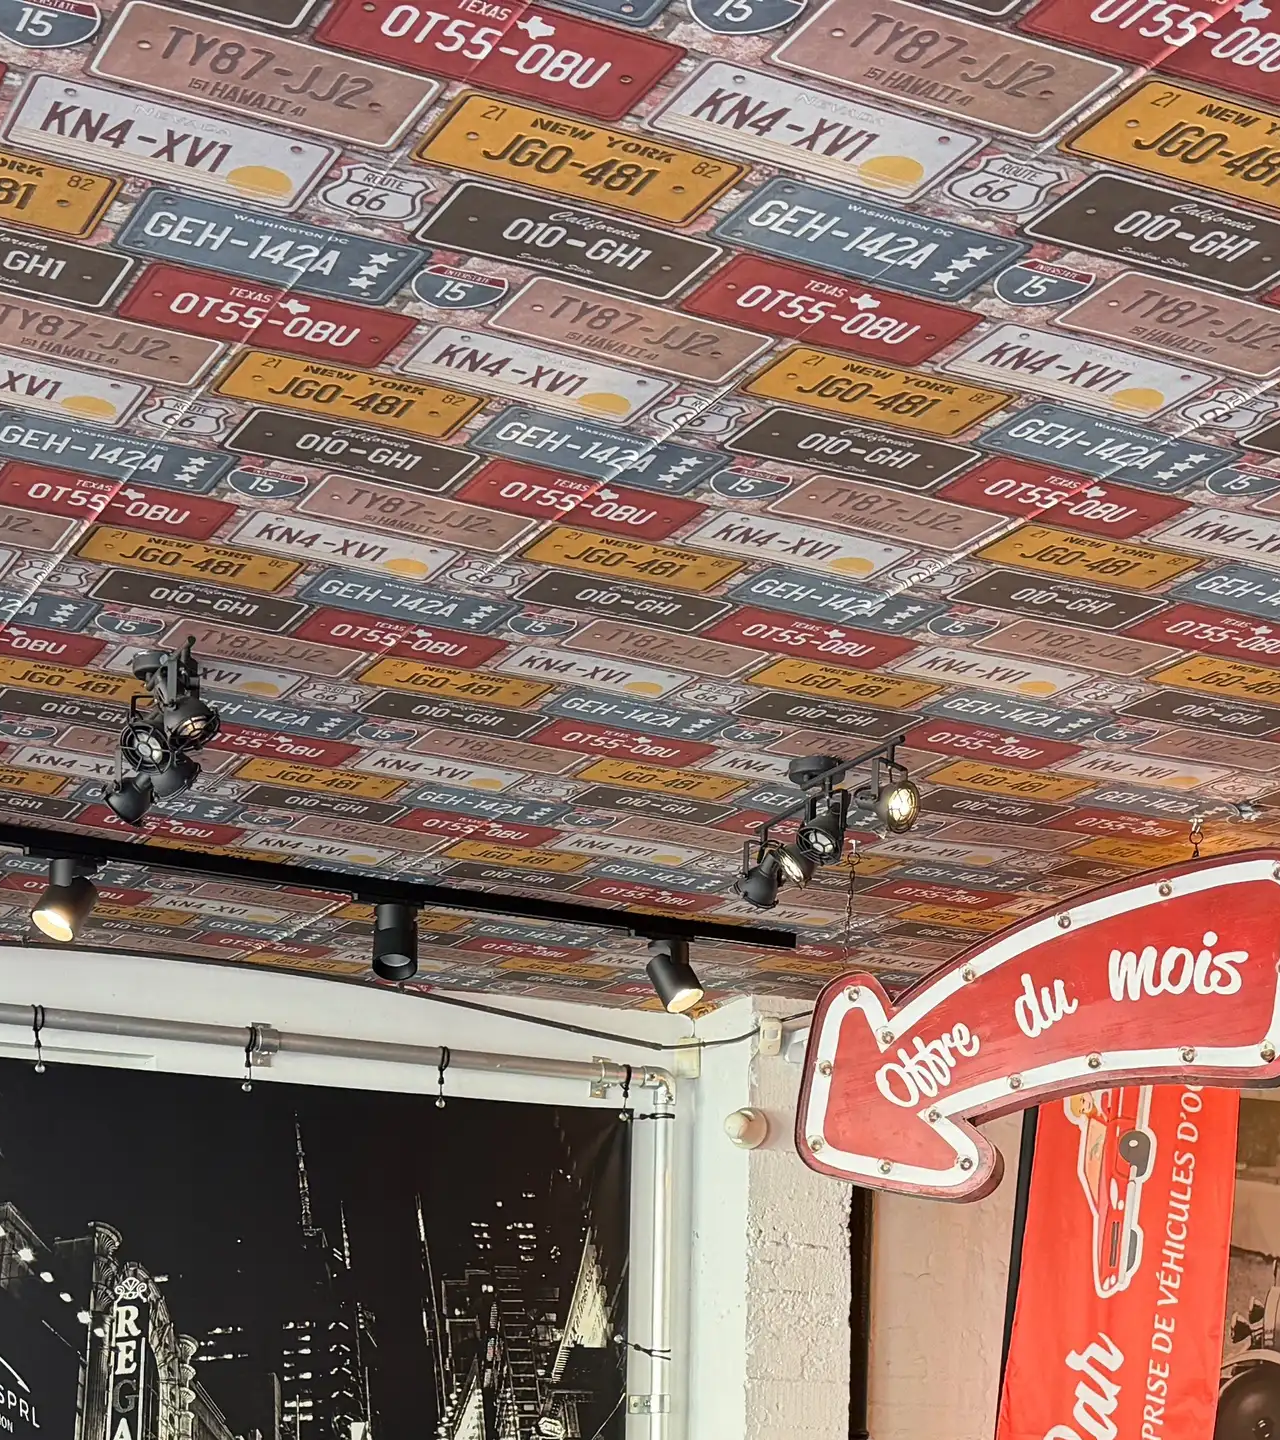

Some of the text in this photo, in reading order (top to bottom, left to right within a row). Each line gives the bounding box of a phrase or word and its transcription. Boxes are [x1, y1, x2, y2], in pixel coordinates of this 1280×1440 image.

[38, 101, 232, 172] KN4-XV1
[528, 117, 677, 163] NEW YORK
[688, 88, 878, 162] KN4-XV1
[1192, 105, 1259, 129] NEW
[360, 173, 411, 190] ROUTE
[478, 135, 662, 195] JGO-481
[993, 163, 1046, 181] ROUTE
[344, 188, 393, 211] 66
[966, 179, 1021, 202] 66
[142, 209, 342, 277] GEH-142A
[747, 199, 940, 269] GEH-142A
[437, 280, 476, 300] 15
[802, 280, 850, 298] TEXAS
[1015, 275, 1062, 296] 15
[1007, 419, 1167, 469] GEH-142A
[876, 930, 1251, 1108] Offre du mois
[1177, 1085, 1204, 1143] D'O
[1156, 1150, 1196, 1306] VÉHICULES
[1152, 1314, 1175, 1354] DE
